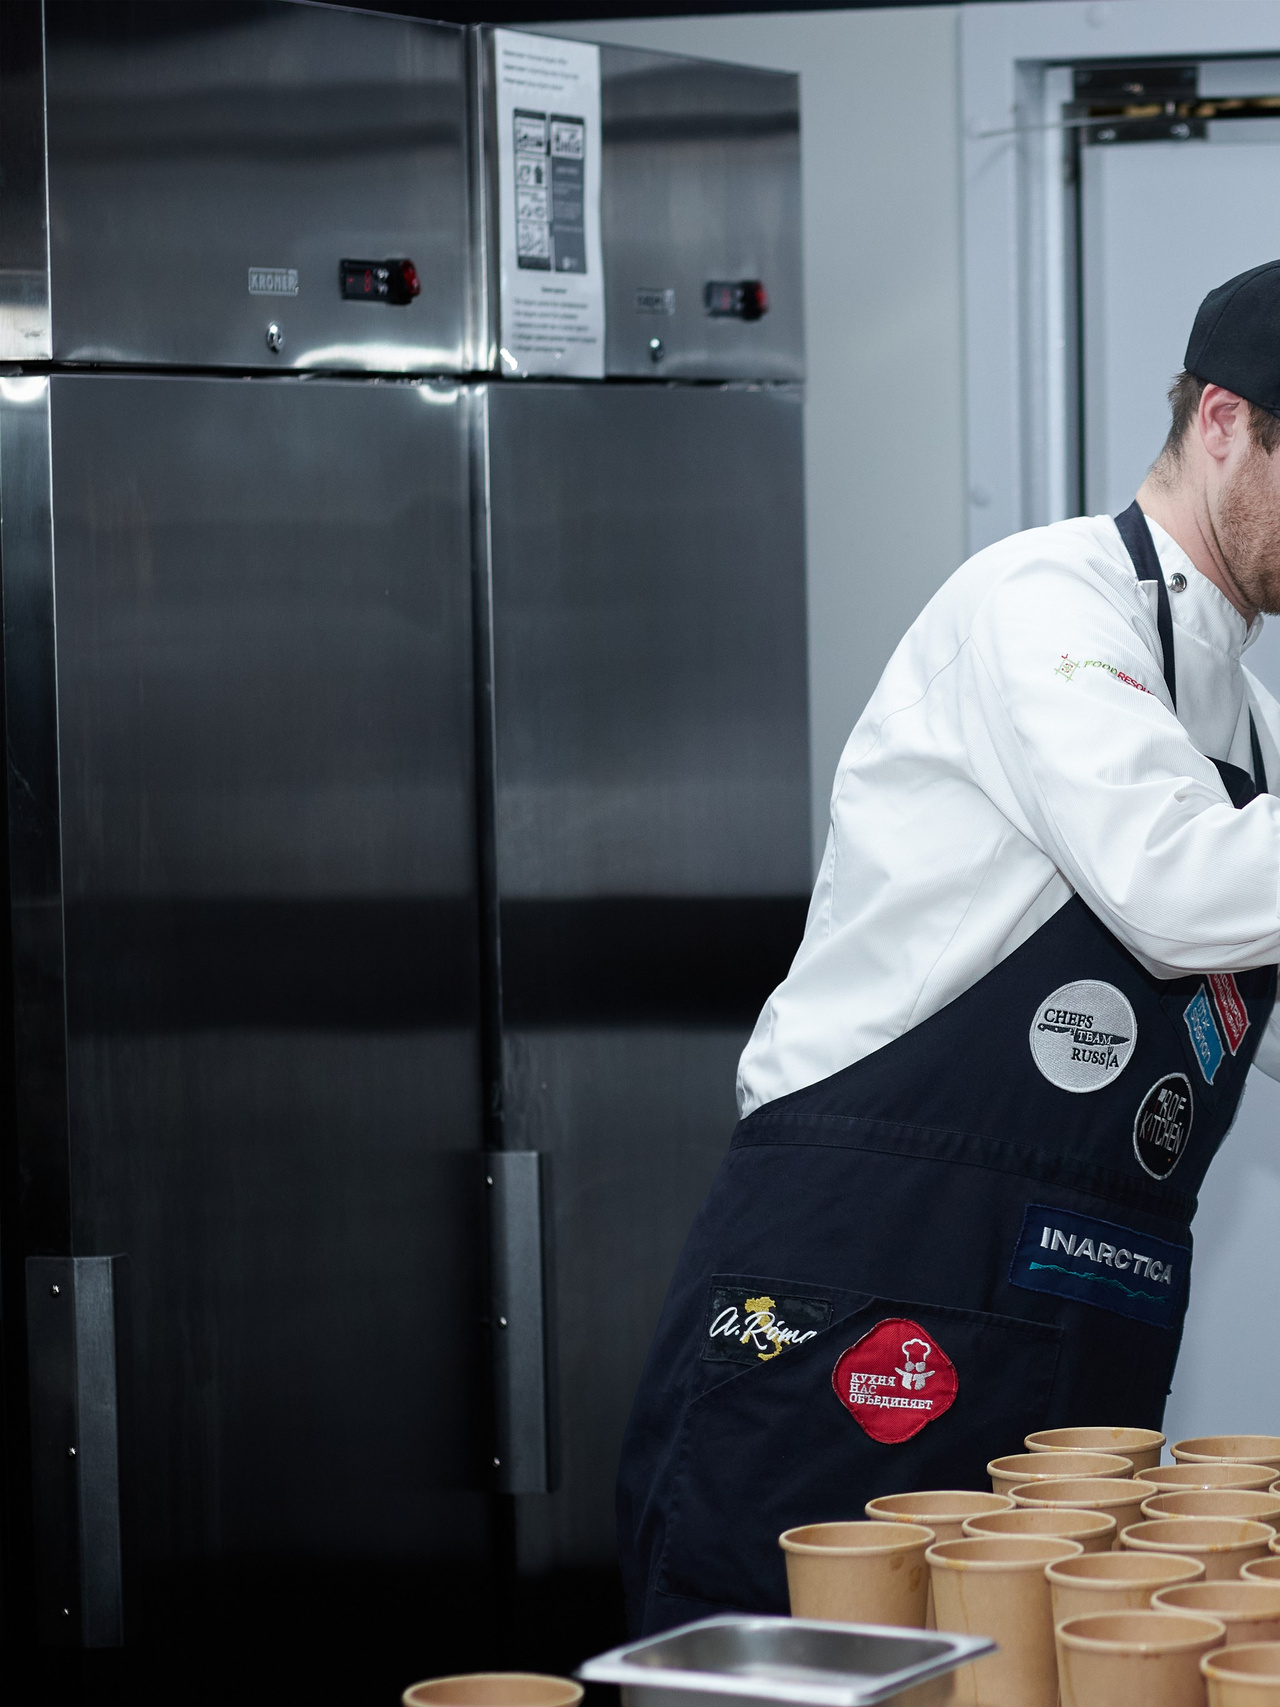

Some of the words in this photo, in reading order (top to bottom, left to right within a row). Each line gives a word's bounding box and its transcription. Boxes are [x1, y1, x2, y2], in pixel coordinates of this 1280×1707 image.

[1044, 1009, 1093, 1029] CHEFS
[1077, 1030, 1114, 1045] TEAM
[1071, 1047, 1119, 1070] RUSSIA
[1139, 1110, 1185, 1154] KITCHEN
[1040, 1226, 1173, 1285] INARCTICA
[849, 1382, 877, 1395] НАС
[850, 1372, 897, 1387] КУХНЯ
[849, 1393, 934, 1410] ОБЪЕДИНЯЕТ
